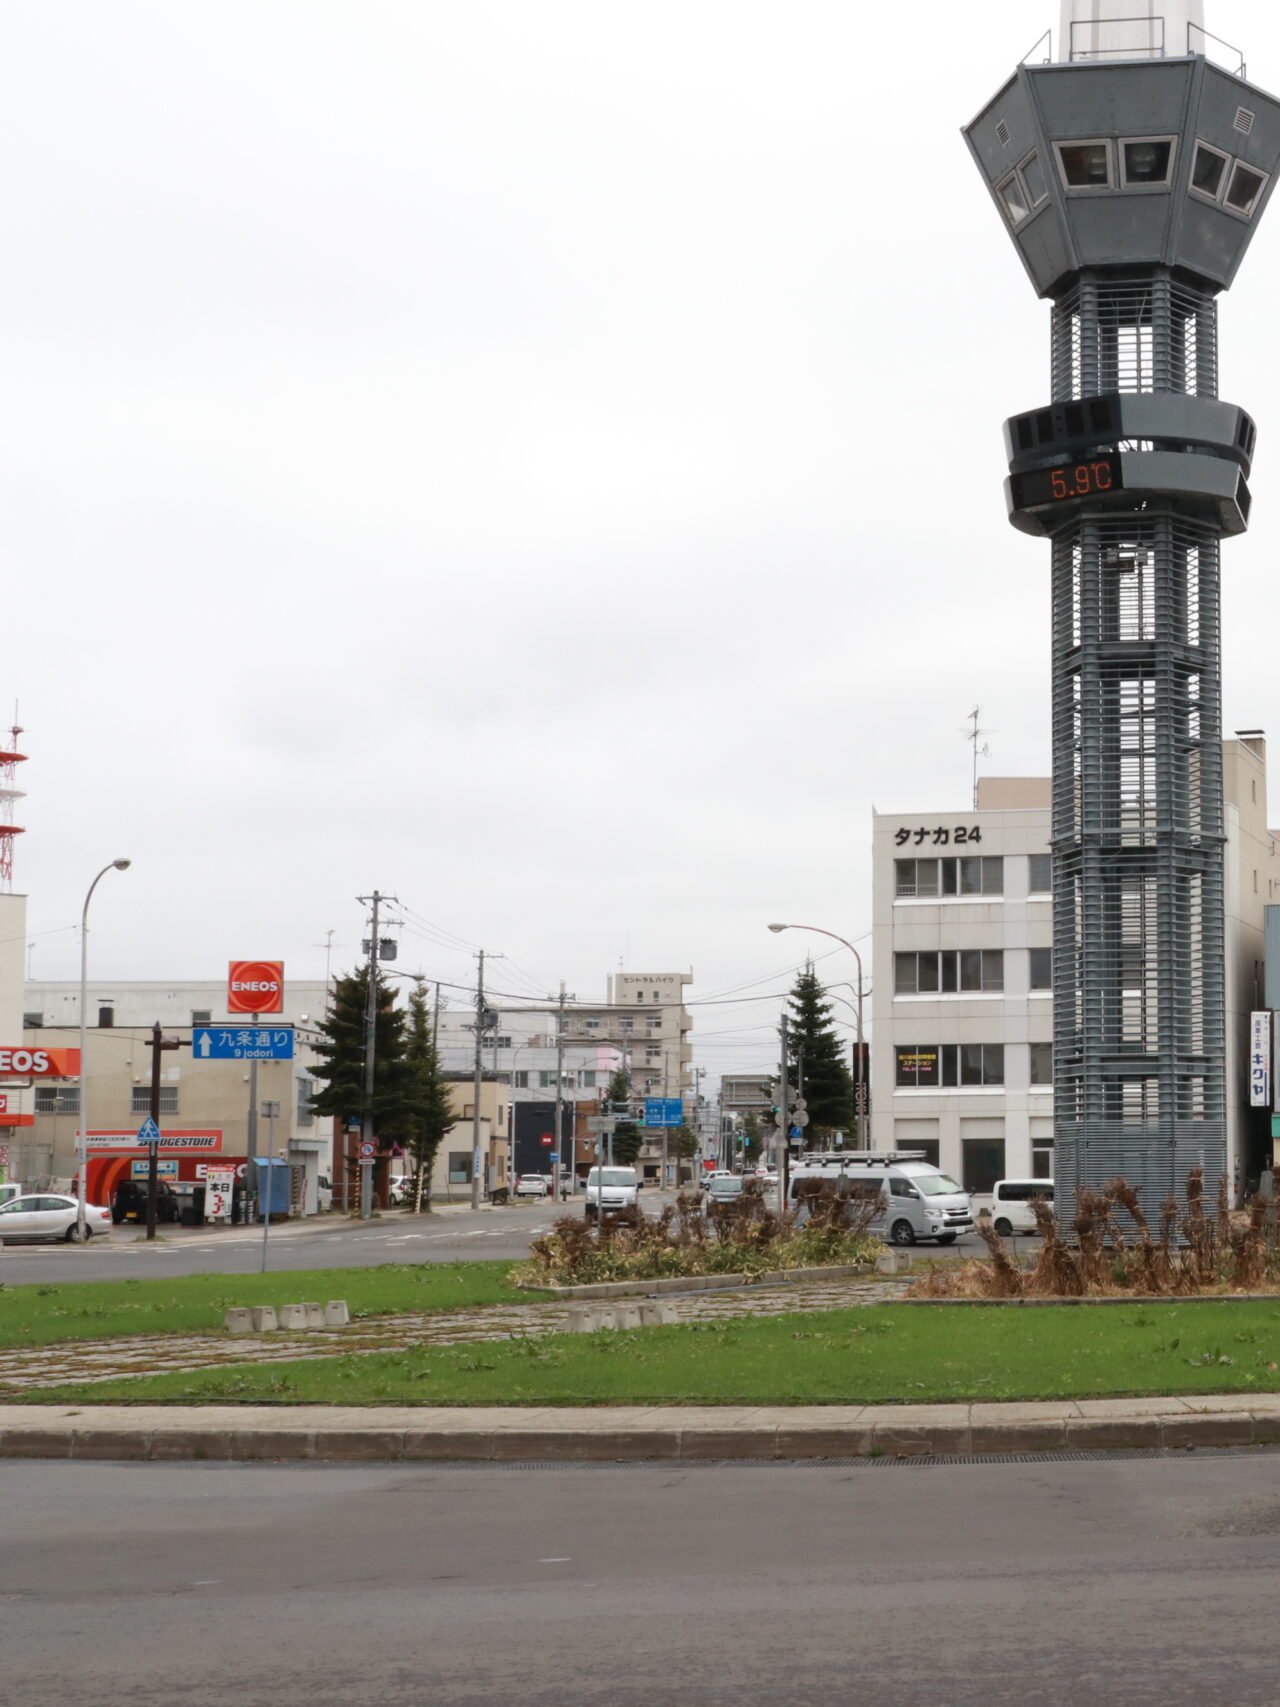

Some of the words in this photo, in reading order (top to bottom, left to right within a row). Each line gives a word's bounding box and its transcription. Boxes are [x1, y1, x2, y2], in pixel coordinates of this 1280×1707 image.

[894, 826, 982, 846] タナカ24
[232, 981, 278, 991] ENEOS
[219, 1031, 288, 1046] 九条通り
[234, 1049, 241, 1057] 9
[243, 1049, 274, 1058] jodori
[1252, 1053, 1264, 1095] キクヤ
[210, 1182, 230, 1193] 本日
